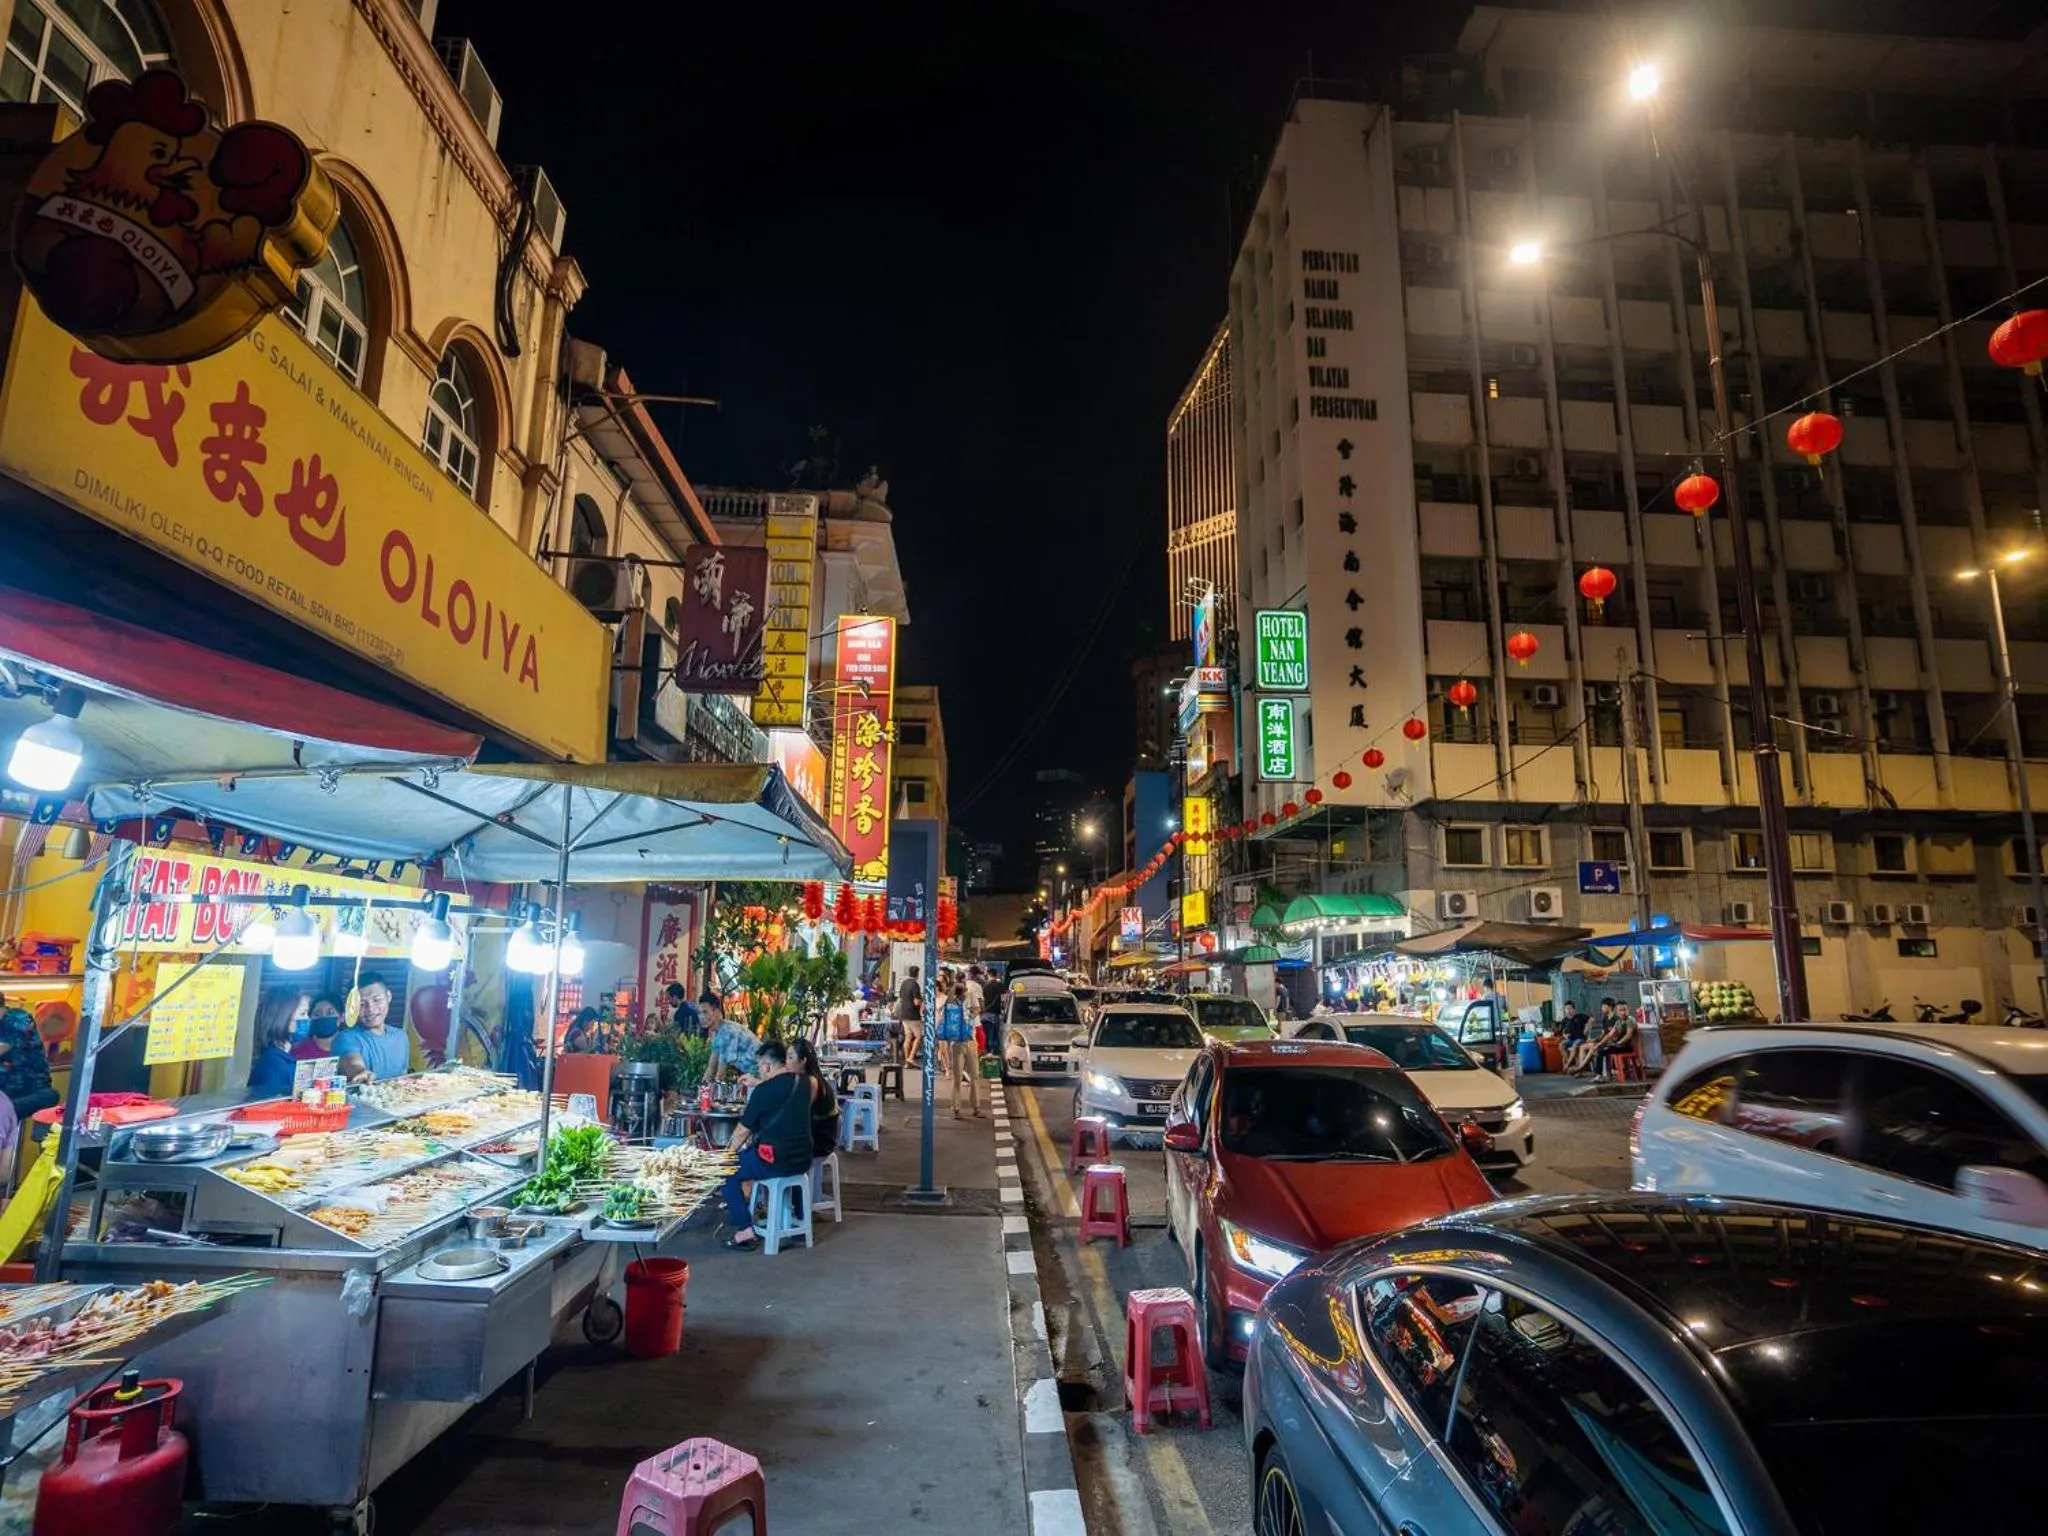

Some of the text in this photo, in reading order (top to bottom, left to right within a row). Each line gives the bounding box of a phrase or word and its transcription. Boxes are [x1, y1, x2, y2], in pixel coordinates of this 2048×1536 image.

[121, 229, 181, 289] OLOIYA
[1302, 249, 1360, 273] PERSATUAN
[1305, 306, 1355, 331] SELANGOR
[1307, 336, 1327, 358] DAN
[1308, 365, 1350, 389] WILAYAH
[1310, 395, 1378, 421] PERSEKUTUAN
[269, 344, 314, 395] SALAI
[315, 386, 327, 406] &
[328, 397, 392, 466] MAKANAN
[393, 455, 436, 503] RINGAN
[74, 468, 147, 522] DIMILIKI
[151, 511, 195, 548] OLEH
[195, 537, 224, 567] Q-Q
[226, 552, 265, 586] FOOD
[267, 575, 309, 612] RETAIL
[310, 600, 333, 624] SDN
[334, 613, 356, 637] BHD
[380, 529, 540, 694] OLOIYA
[1261, 616, 1302, 638] HOTEL
[1269, 639, 1296, 661] NAN
[1202, 670, 1224, 682] KK
[1263, 661, 1303, 683] YEANG
[1266, 703, 1288, 774] 南洋酒店
[1594, 868, 1604, 882] P
[124, 857, 261, 944] FAT BOY
[1121, 910, 1141, 923] KK
